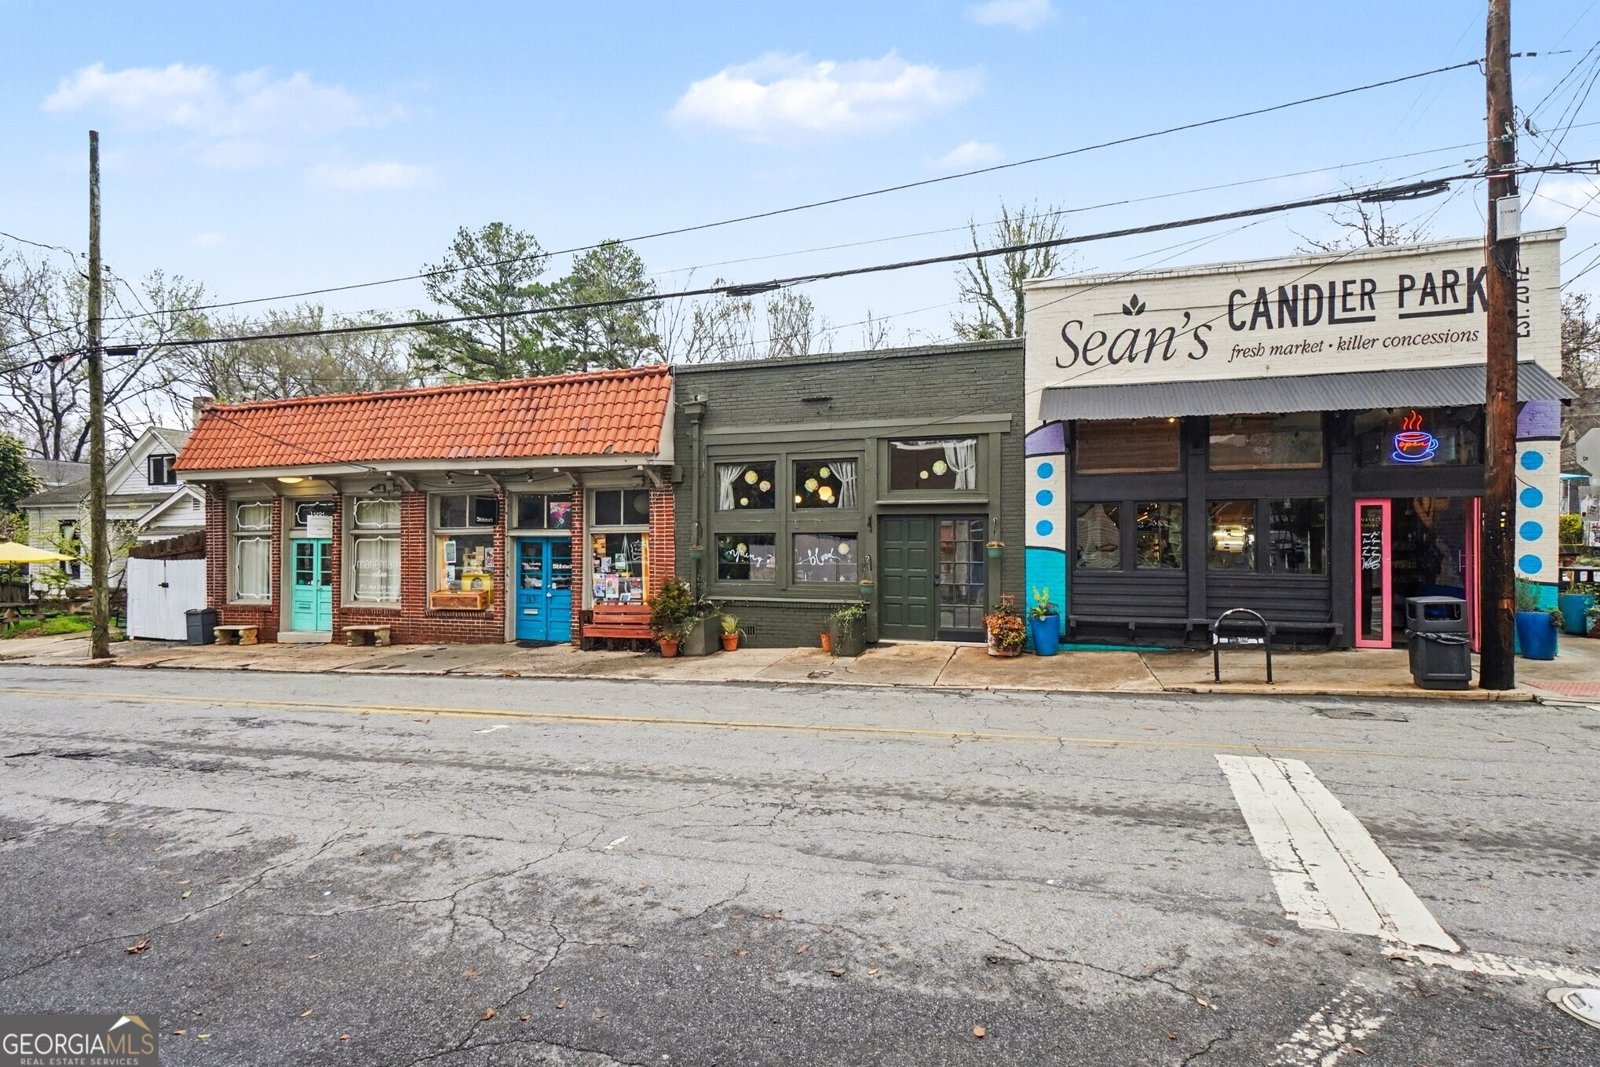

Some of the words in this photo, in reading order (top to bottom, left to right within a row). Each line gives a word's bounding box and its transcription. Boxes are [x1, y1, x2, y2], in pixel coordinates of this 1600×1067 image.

[1228, 278, 1377, 331] CANDLER
[1398, 266, 1488, 319] PARK
[1056, 310, 1212, 368] Sean's
[1228, 343, 1265, 363] fresh
[1269, 338, 1323, 356] market
[1337, 334, 1379, 351] killer
[1382, 328, 1480, 348] concessions
